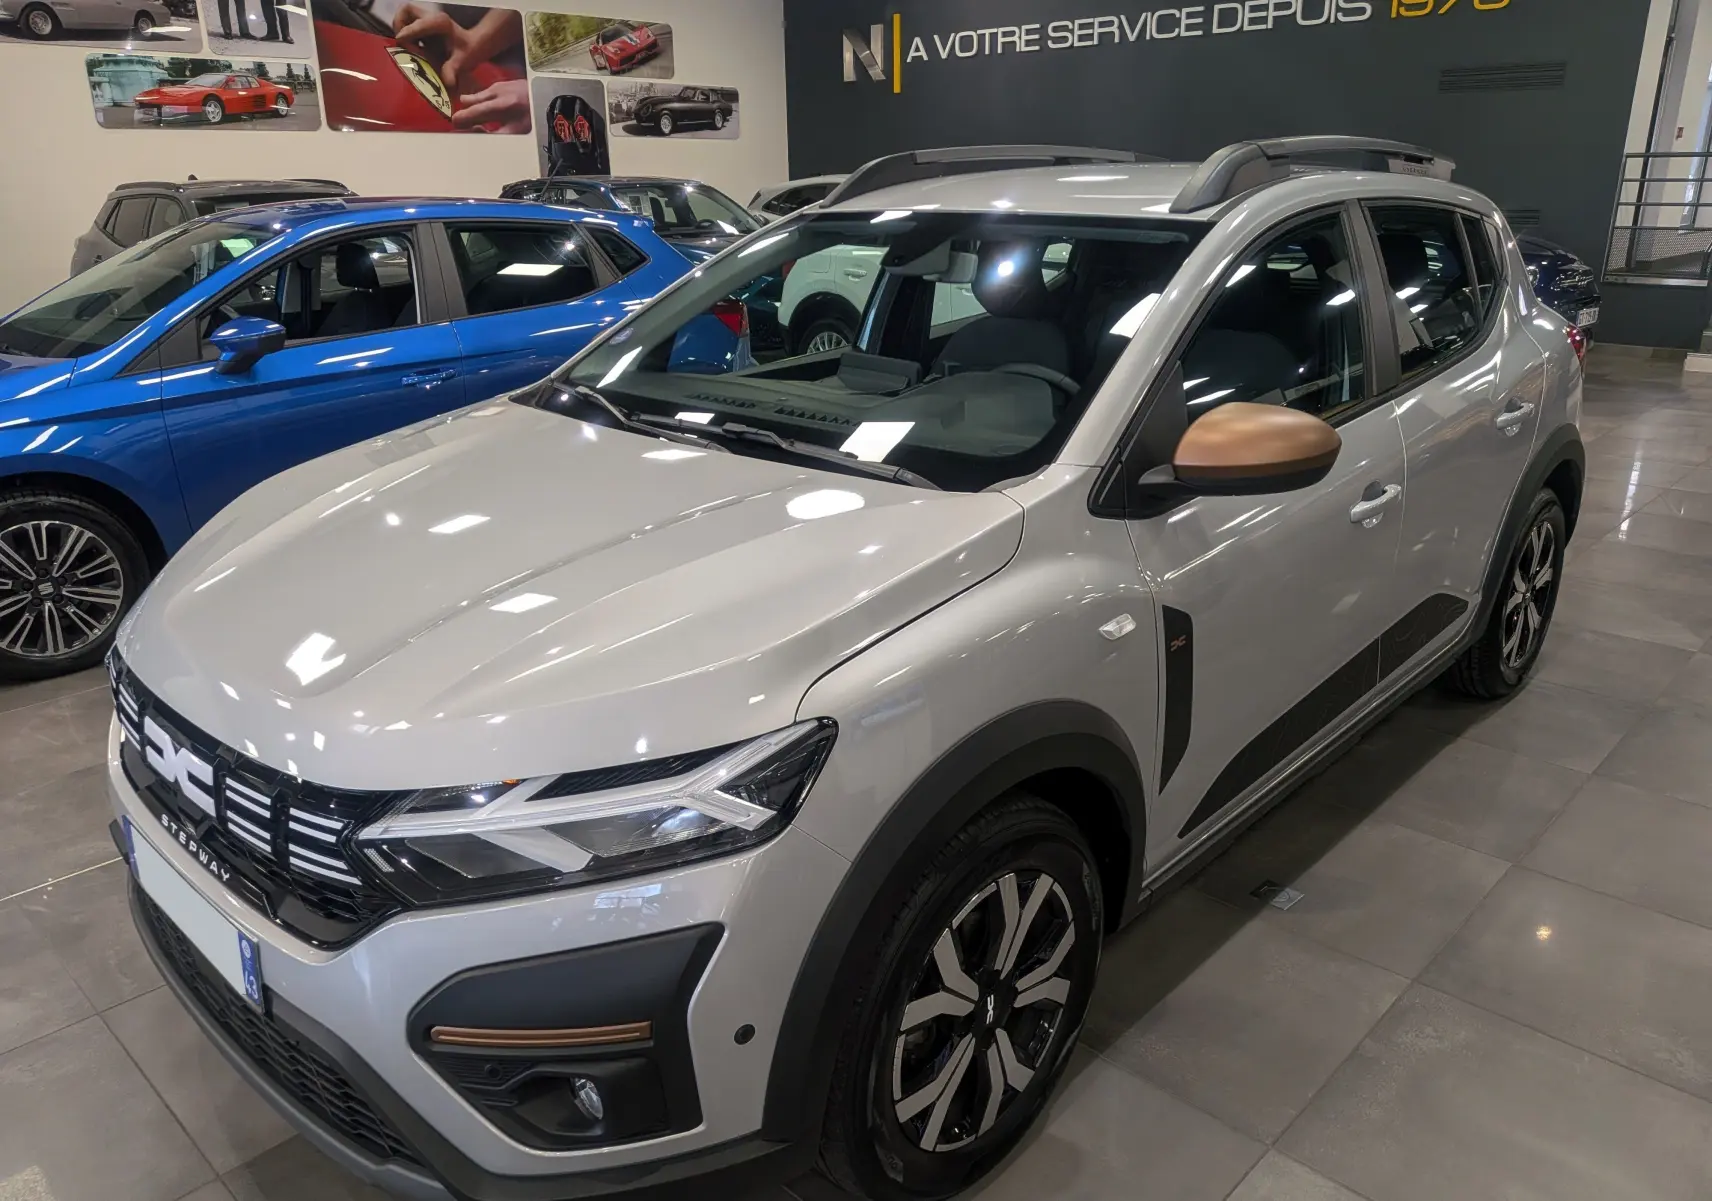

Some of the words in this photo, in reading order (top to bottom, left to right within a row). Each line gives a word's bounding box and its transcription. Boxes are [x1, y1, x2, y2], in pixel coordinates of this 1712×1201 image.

[906, 36, 928, 63] A
[933, 23, 1041, 60] VOTRE
[1047, 5, 1206, 49] SERVICE
[1211, 0, 1373, 34] DEPUIS
[161, 813, 230, 882] STEPWAY
